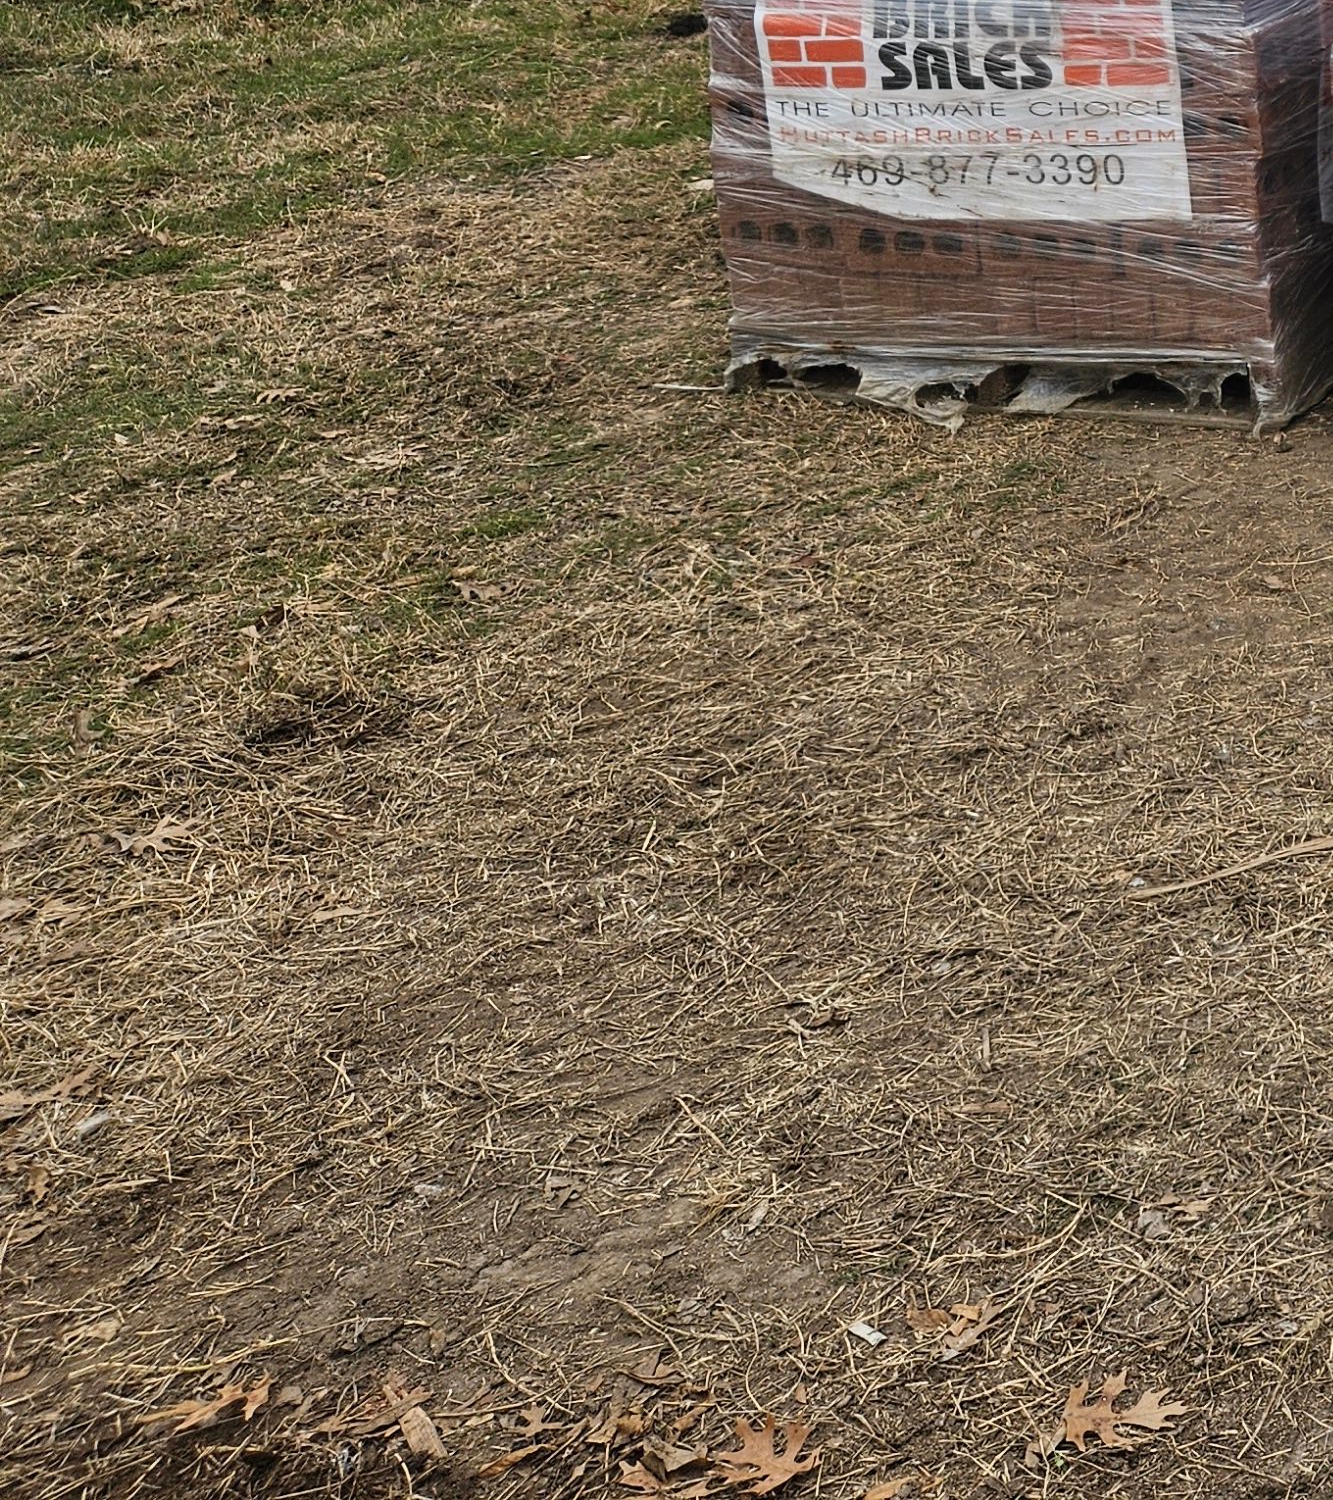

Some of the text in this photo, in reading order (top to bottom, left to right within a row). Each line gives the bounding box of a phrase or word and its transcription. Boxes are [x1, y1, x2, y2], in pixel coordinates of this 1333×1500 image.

[878, 39, 1053, 91] SALES
[777, 100, 1171, 117] THE ULTIMATE CHOICE
[831, 153, 1125, 185] 469-877-3390
